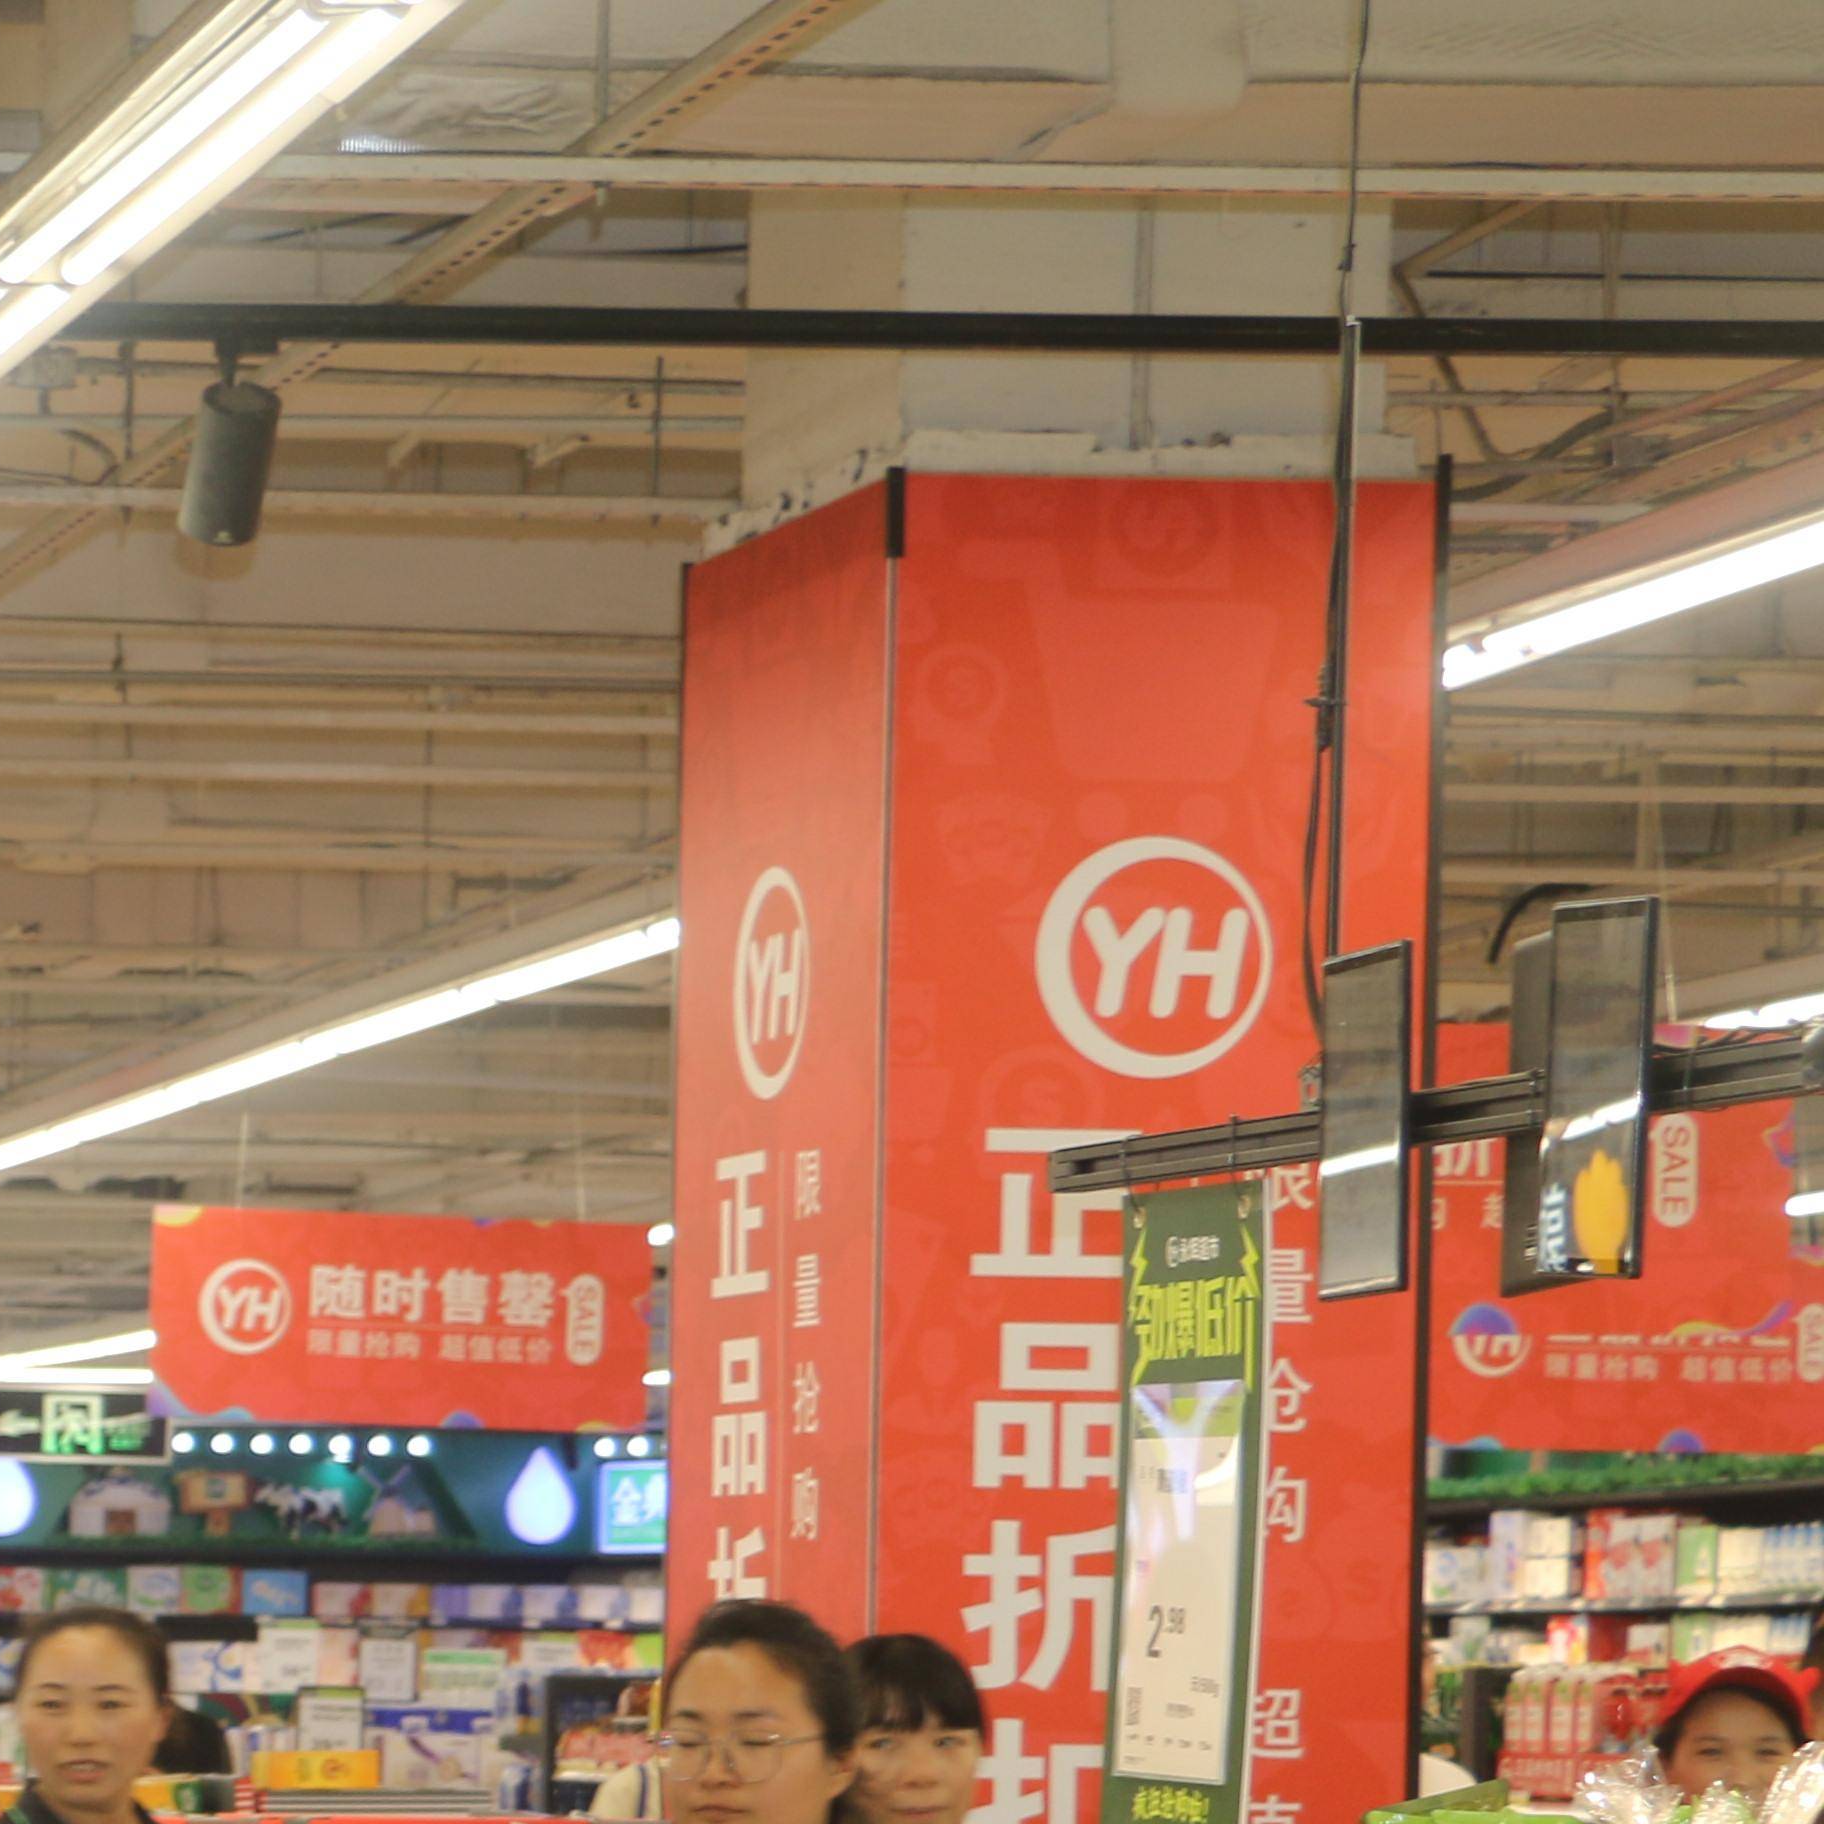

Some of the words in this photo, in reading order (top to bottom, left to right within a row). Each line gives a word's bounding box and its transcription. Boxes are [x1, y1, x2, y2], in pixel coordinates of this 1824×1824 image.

[1661, 1123, 1691, 1219] SALE
[306, 1264, 557, 1328] 随时售罄
[791, 1148, 823, 1541] 限量抢购
